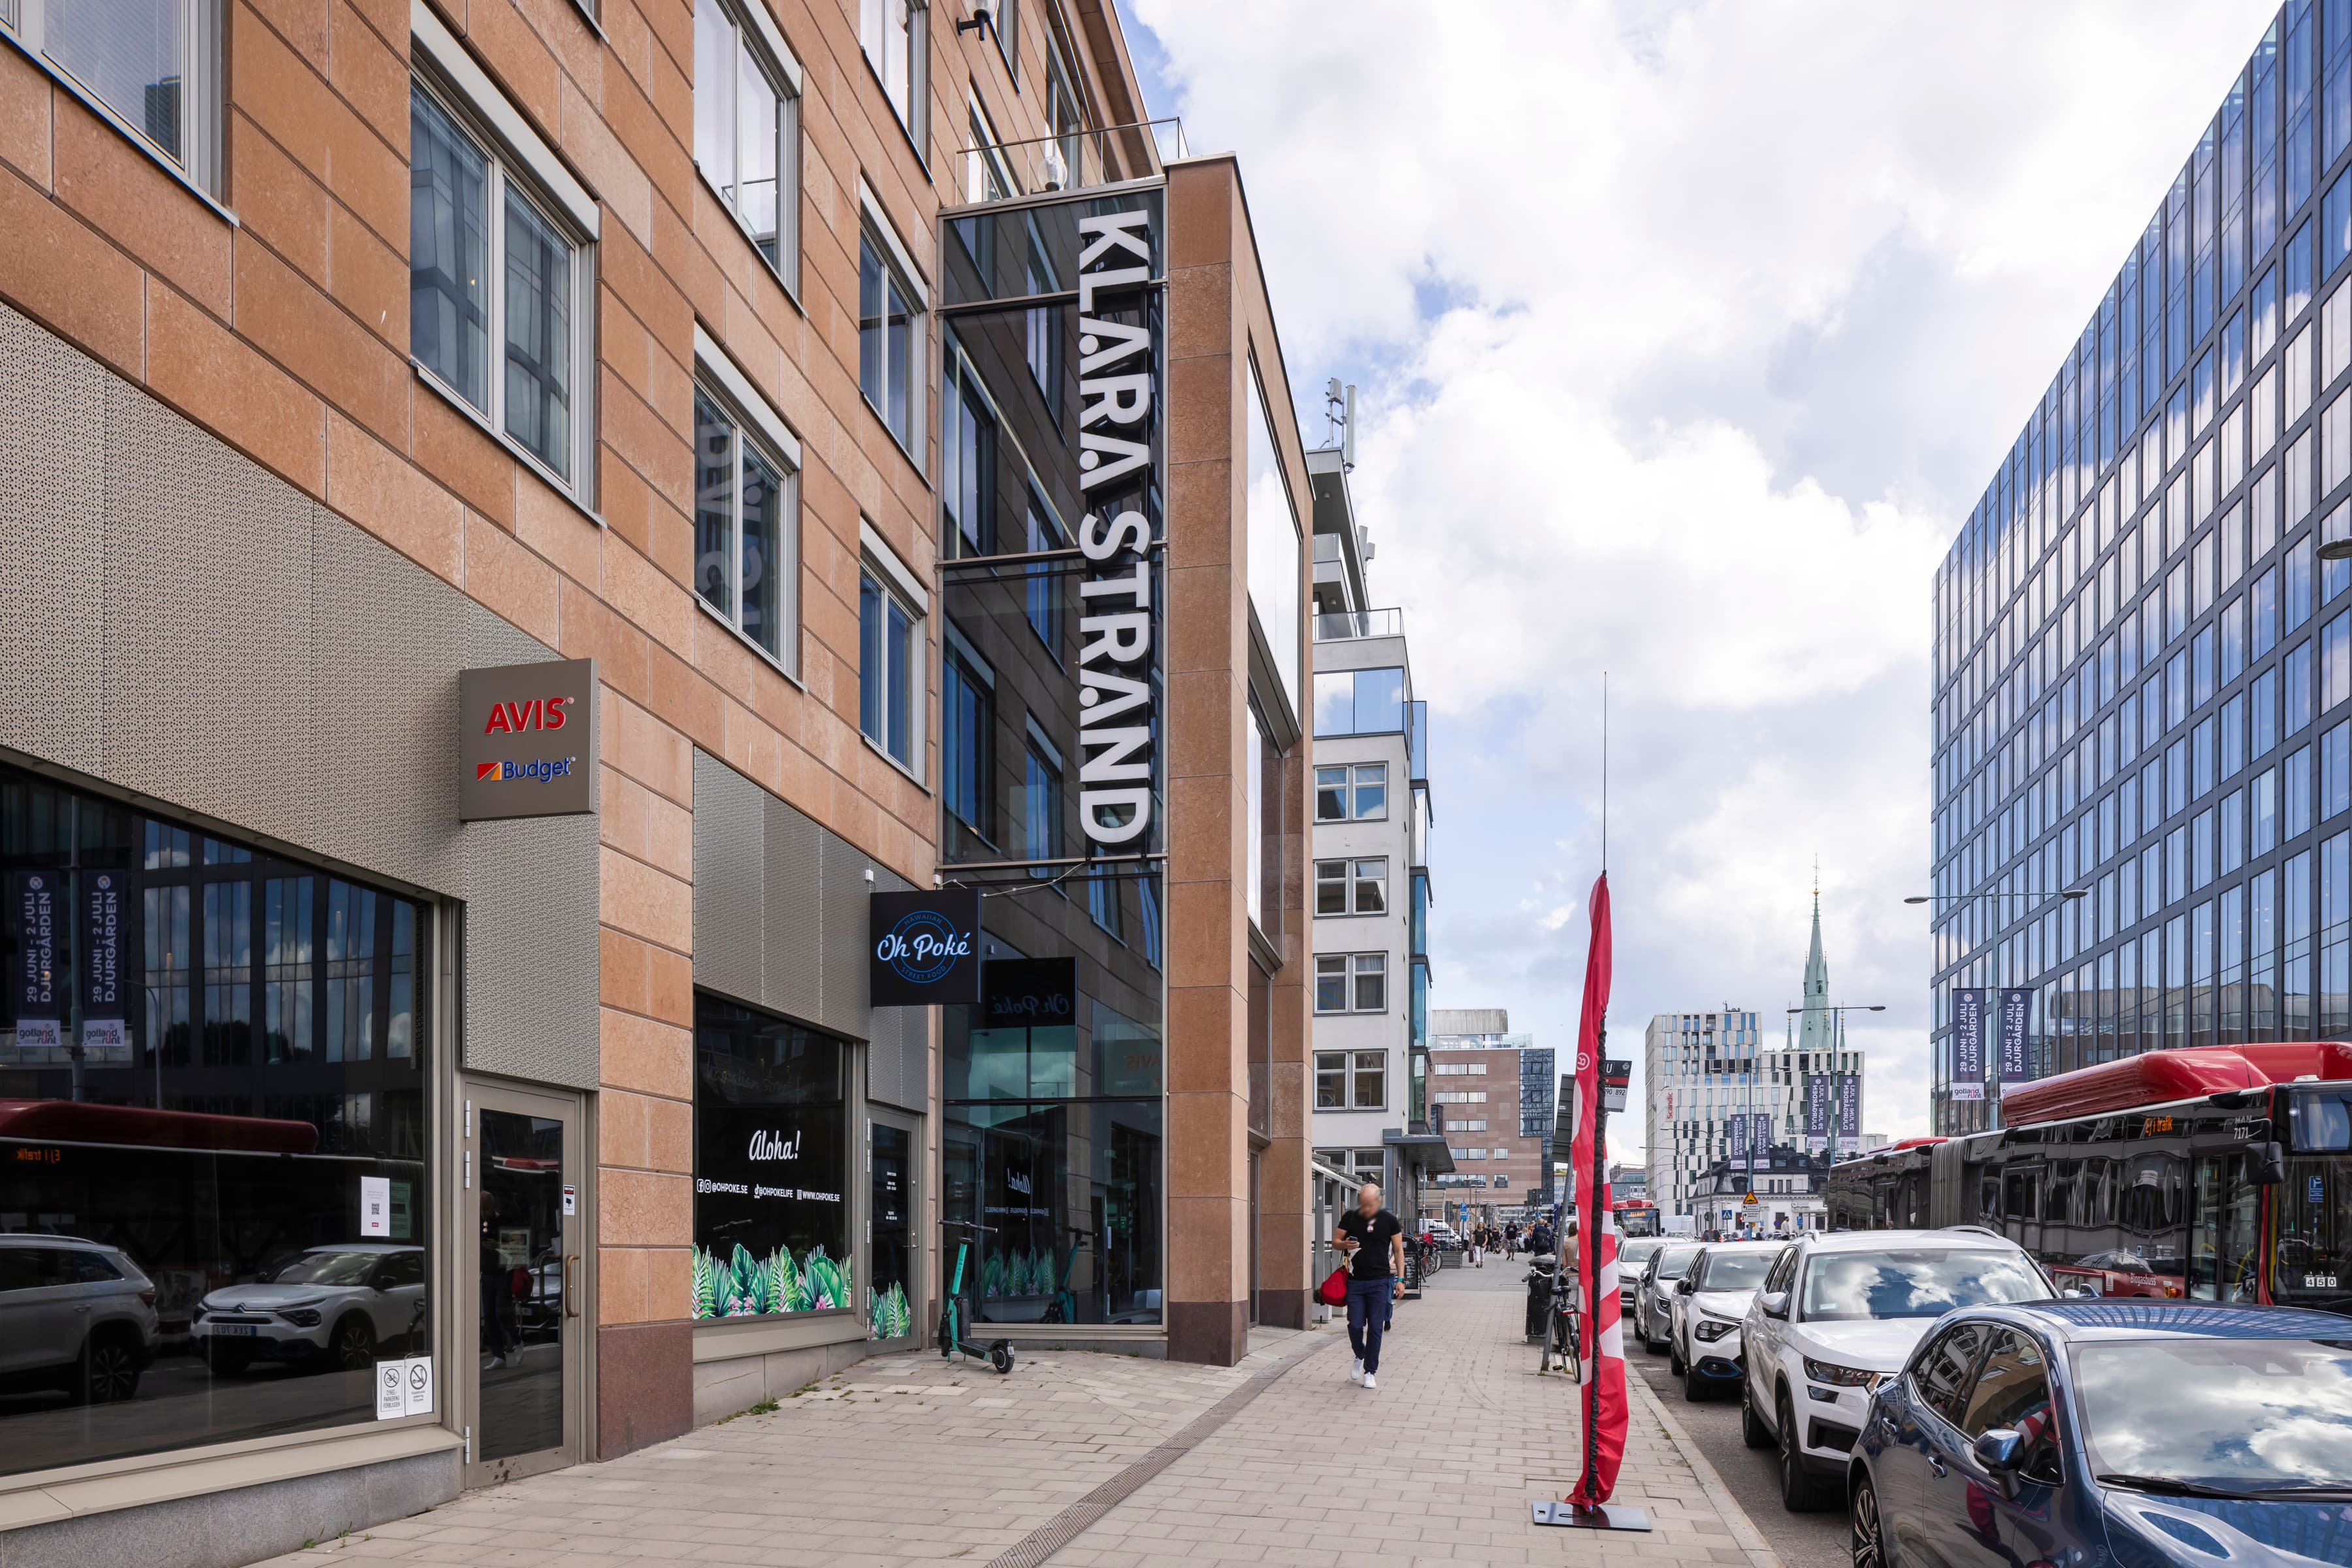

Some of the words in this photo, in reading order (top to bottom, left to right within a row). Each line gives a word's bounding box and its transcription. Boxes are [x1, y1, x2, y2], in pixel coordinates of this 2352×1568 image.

[1079, 210, 1150, 491] KLARA
[1079, 511, 1151, 843] STRAND
[484, 697, 566, 734] AVIS
[504, 757, 571, 783] Budget
[24, 892, 36, 924] JULI
[91, 892, 102, 924] JULI
[904, 915, 943, 925] HAWAIIAN
[93, 926, 102, 935] 2
[37, 892, 52, 1002] DJURGÅRDEN
[102, 892, 117, 1002] DJURGÅRDEN
[877, 934, 911, 960] Oh
[913, 932, 971, 961] Poké
[27, 949, 37, 983] JUNI
[93, 949, 103, 983] JUNI
[901, 967, 924, 980] STREET
[928, 966, 946, 979] FOOD
[27, 986, 37, 1002] 29
[93, 986, 102, 1002] 29
[1967, 1004, 1977, 1072] DJURGÅRDEN
[2012, 1004, 2025, 1072] DJURGÅRDEN
[1960, 1062, 1967, 1072] 29
[2005, 1062, 2013, 1072] 29
[2146, 1118, 2153, 1136] Ej
[2157, 1115, 2174, 1132] trafik
[2234, 1127, 2249, 1139] 7171
[749, 1130, 800, 1160] Aloha!
[711, 1183, 747, 1194] @OHPOKE.SE
[759, 1187, 793, 1198] @OHPOKELIFE
[802, 1191, 840, 1201] WWW.OHPOKE.SE
[2131, 1273, 2157, 1286] Biogasbuss
